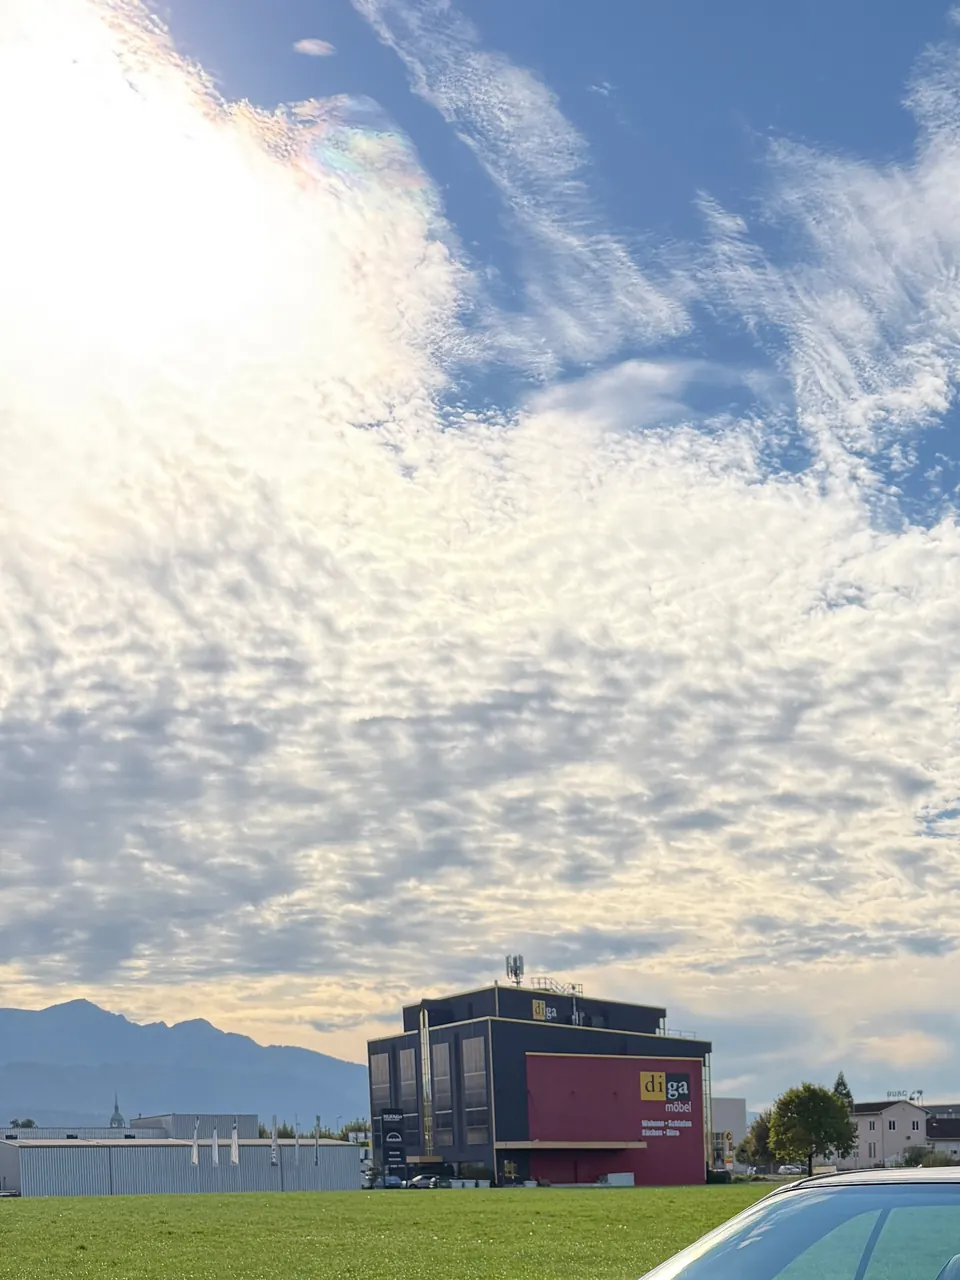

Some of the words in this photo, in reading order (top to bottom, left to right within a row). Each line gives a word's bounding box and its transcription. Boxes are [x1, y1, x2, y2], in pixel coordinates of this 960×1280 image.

[535, 1001, 557, 1020] diga
[645, 1074, 689, 1099] diga
[665, 1101, 692, 1112] möbel
